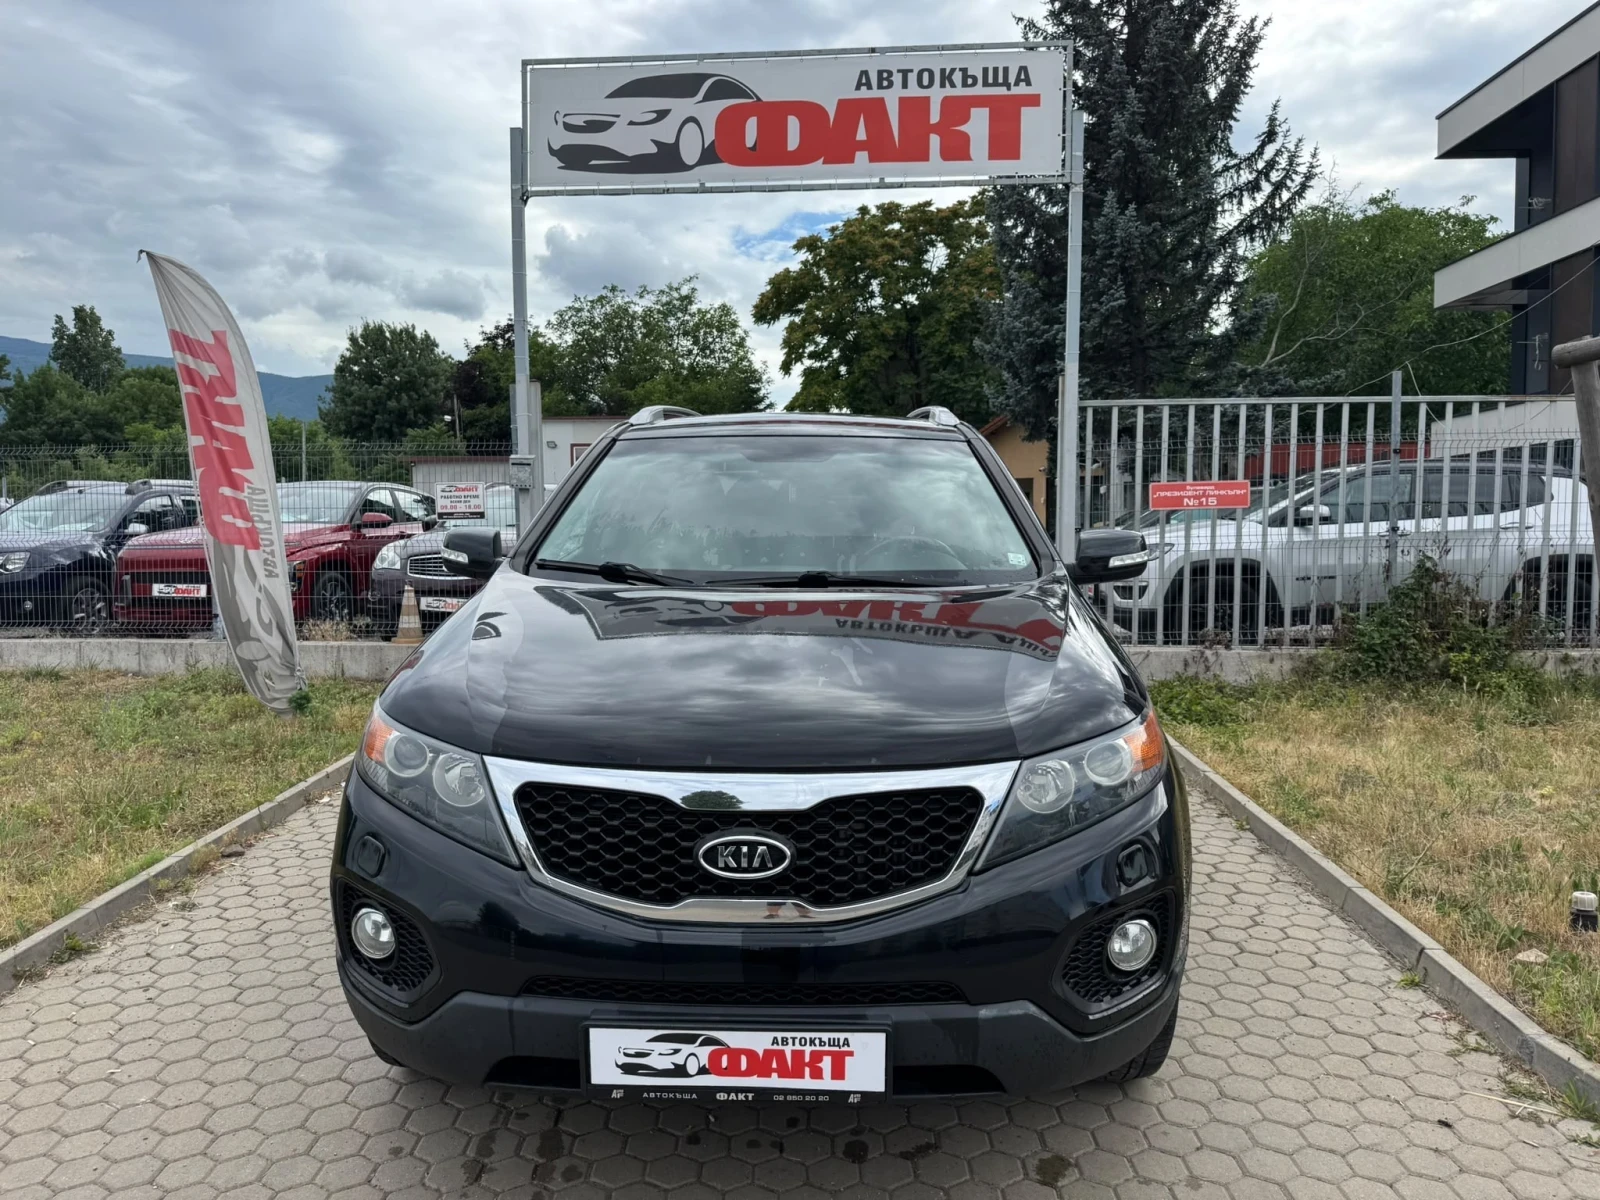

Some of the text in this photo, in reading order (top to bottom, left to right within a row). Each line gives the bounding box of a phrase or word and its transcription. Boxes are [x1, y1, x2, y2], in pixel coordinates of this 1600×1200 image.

[854, 65, 1032, 92] АВТОКЪЩА
[714, 93, 1041, 167] ФАКТ
[1183, 497, 1217, 506] №15
[717, 846, 773, 868] KIA
[771, 1036, 851, 1048] АВТОКЪЩА
[708, 1047, 854, 1080] ФАКТ
[716, 1092, 755, 1101] ФАКТ
